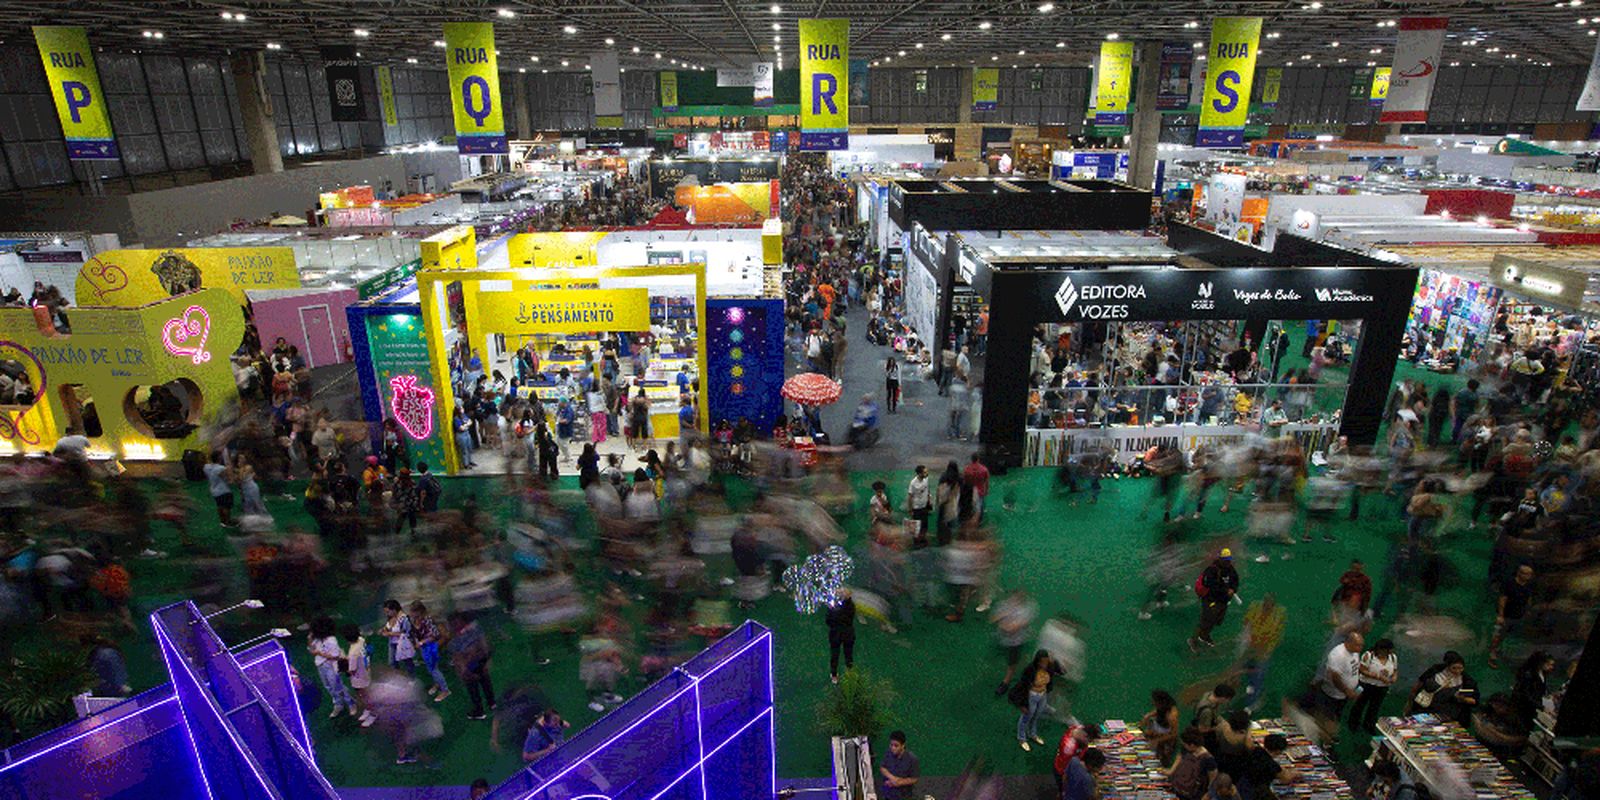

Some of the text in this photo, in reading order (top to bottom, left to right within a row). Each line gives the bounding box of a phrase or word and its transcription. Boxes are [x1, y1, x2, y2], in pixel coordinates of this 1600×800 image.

[455, 48, 489, 65] RUA
[808, 44, 841, 61] RUA
[1217, 43, 1249, 59] RUA
[50, 52, 86, 68] RUA
[812, 73, 838, 115] R
[1213, 70, 1241, 114] S
[62, 81, 92, 123] P
[462, 75, 492, 127] Q
[231, 271, 275, 285] DE LER
[1081, 284, 1146, 301] EDITORA
[1260, 288, 1273, 302] de
[532, 310, 614, 324] PENSAMENTO
[1077, 304, 1129, 319] VOZES
[90, 348, 112, 365] DE
[116, 348, 145, 365] LER
